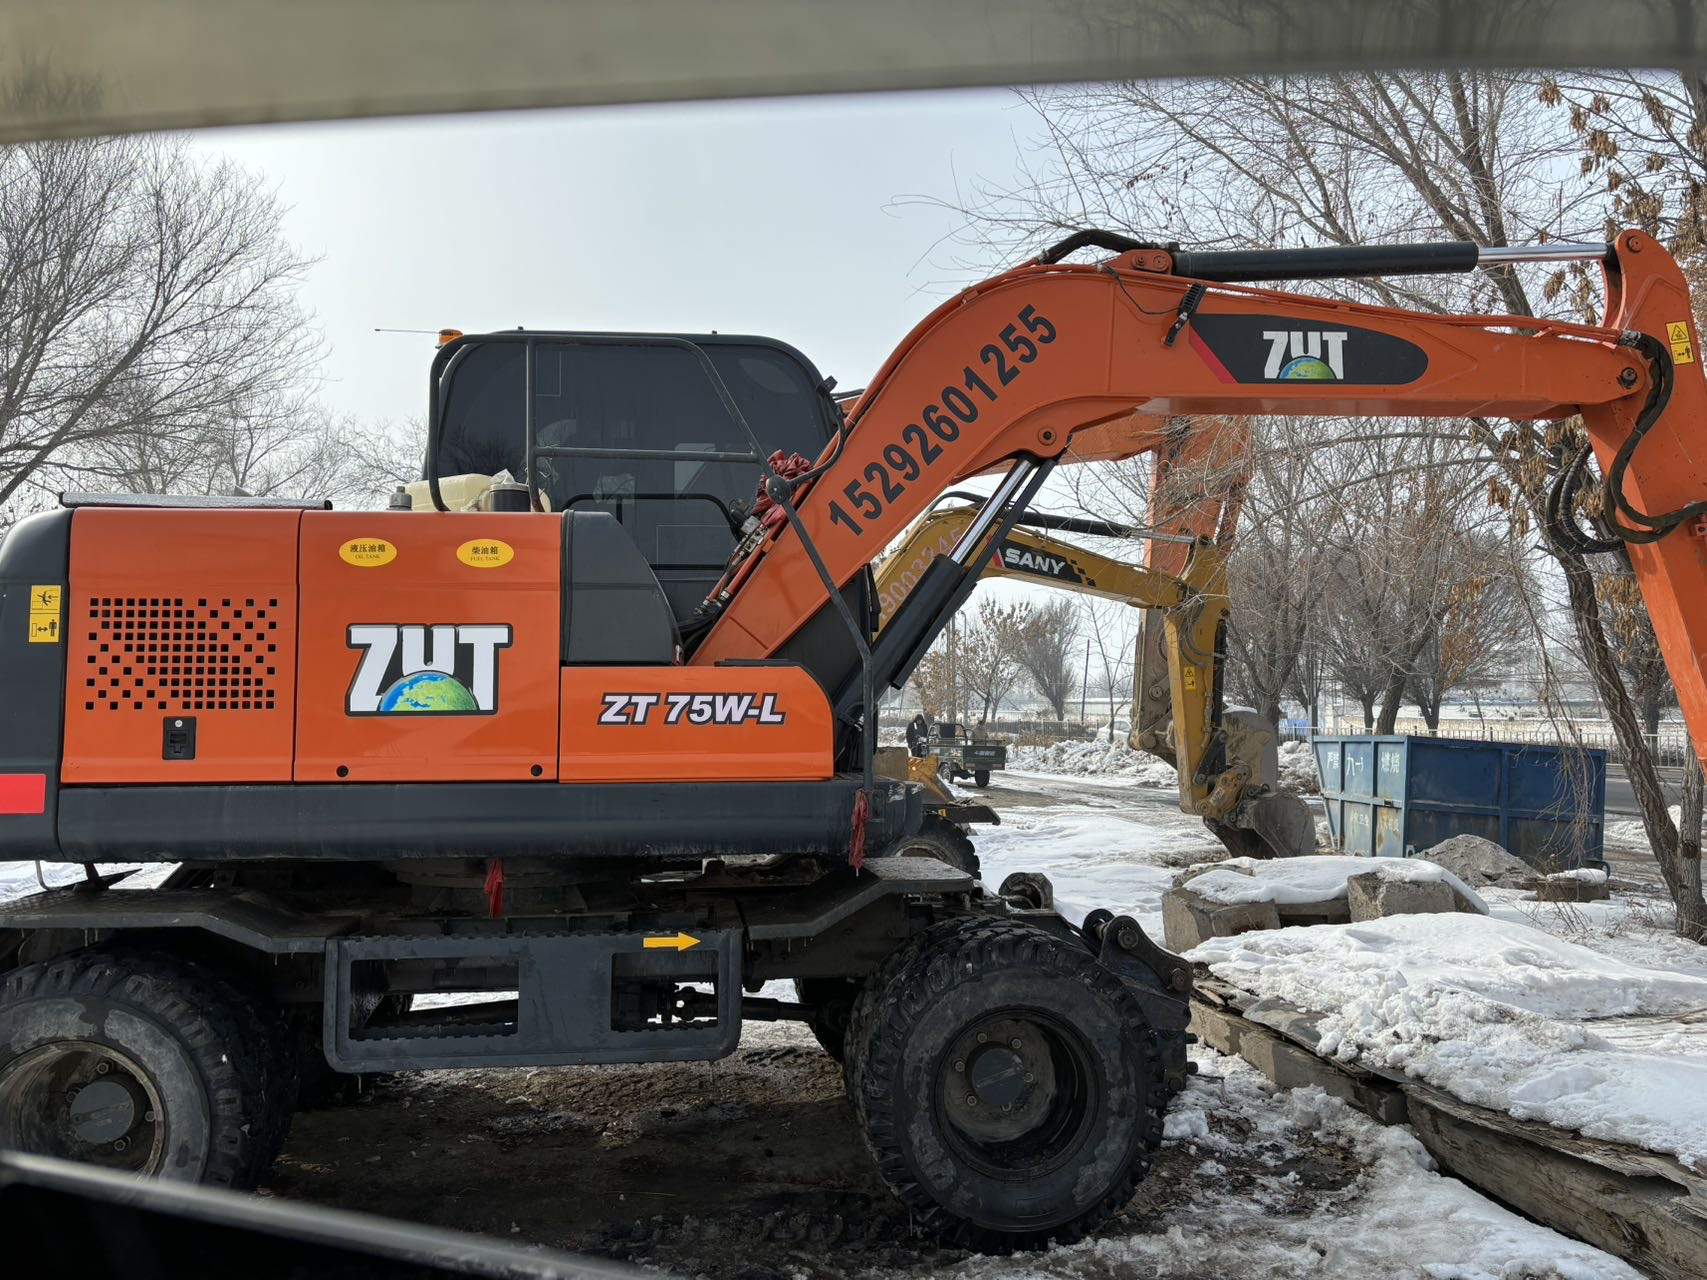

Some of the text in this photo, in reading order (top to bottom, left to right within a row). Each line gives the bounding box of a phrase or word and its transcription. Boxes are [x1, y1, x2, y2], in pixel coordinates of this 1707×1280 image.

[1263, 331, 1348, 380] ZUT
[828, 304, 1057, 536] 15292601255
[350, 543, 386, 553] 液压油箱
[471, 546, 499, 555] 柴油箱
[1005, 547, 1066, 575] SANY
[348, 624, 511, 714] ZUT
[599, 694, 785, 724] ZT 75W-L
